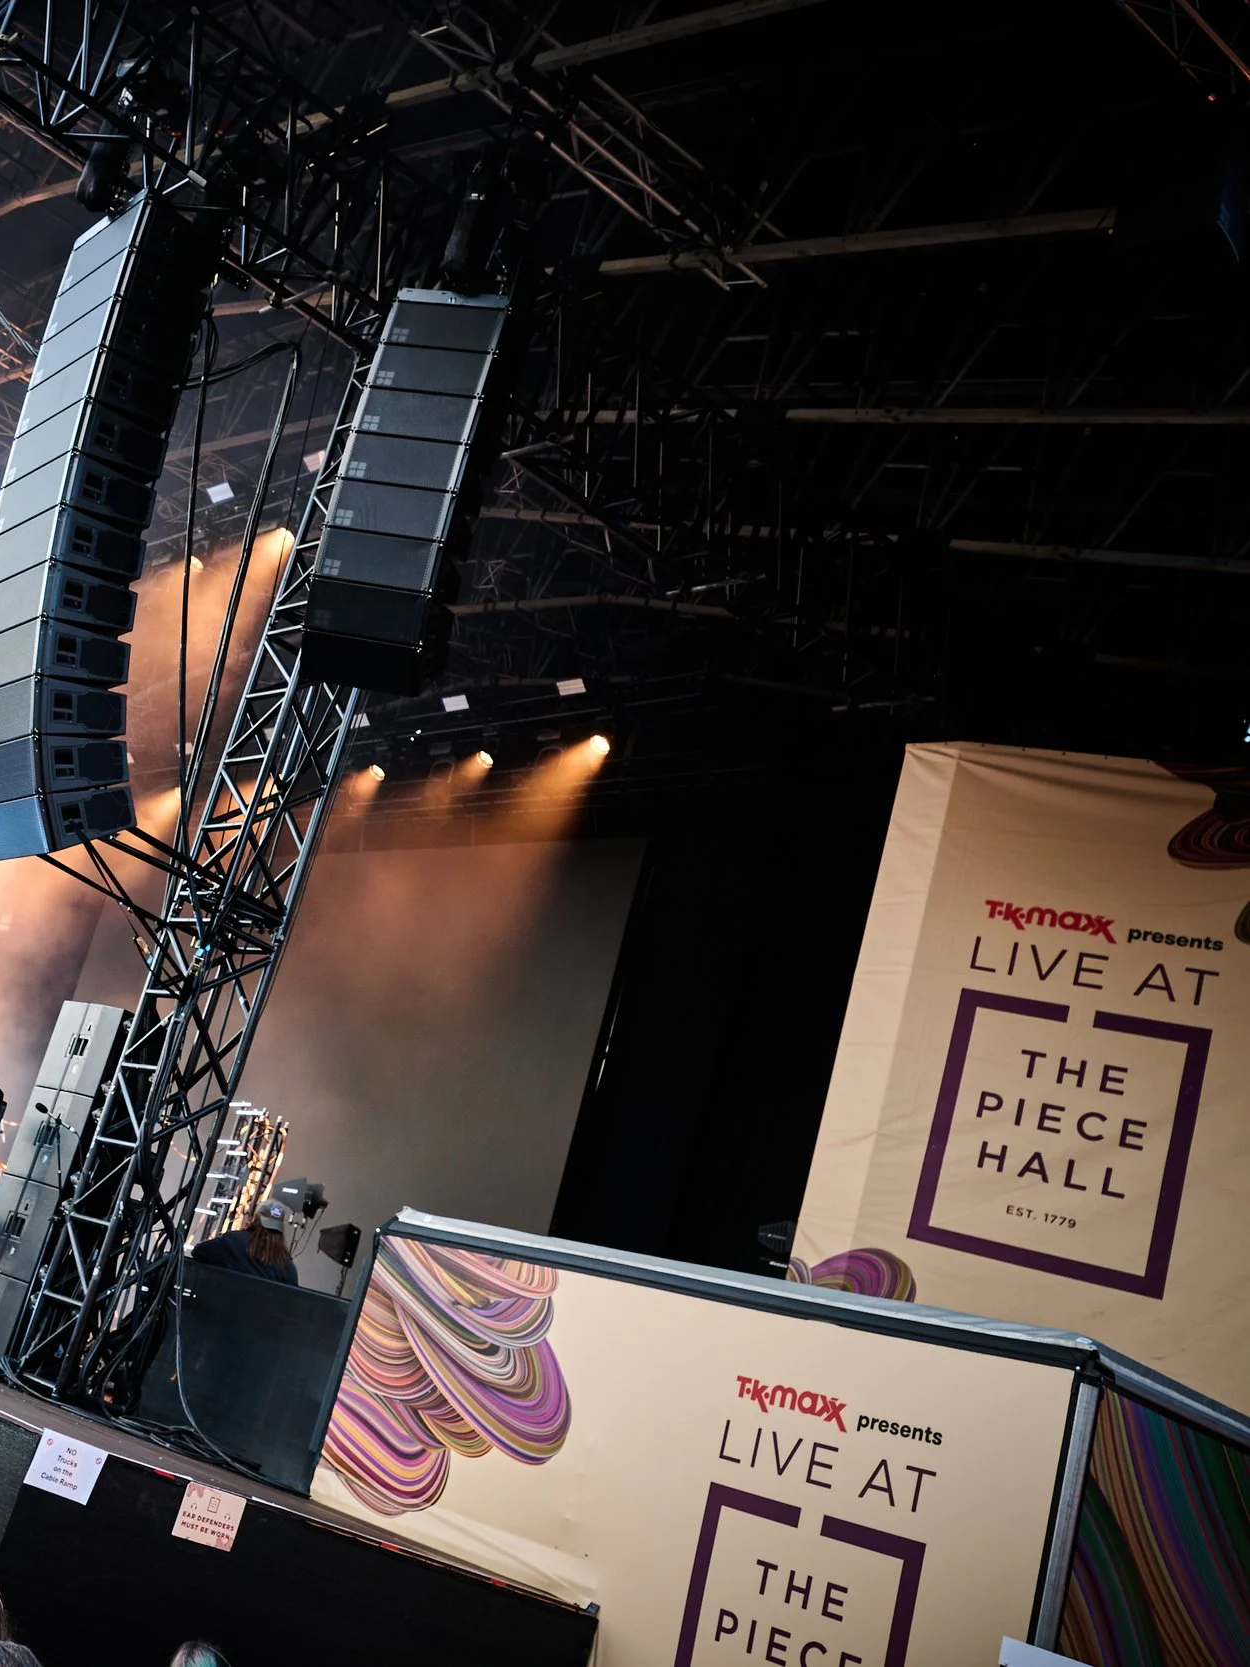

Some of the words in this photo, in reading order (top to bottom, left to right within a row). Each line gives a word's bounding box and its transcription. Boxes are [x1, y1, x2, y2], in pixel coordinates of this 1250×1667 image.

[1127, 928, 1224, 951] presents
[970, 935, 1110, 990] LIVE
[1133, 963, 1220, 1006] AT
[1021, 1049, 1129, 1096] THE
[976, 1091, 1148, 1151] PIECE
[977, 1141, 1125, 1199] HALL
[1006, 1204, 1038, 1221] EST.
[1043, 1212, 1077, 1229] 1779
[856, 1414, 944, 1446] presents
[57, 1455, 78, 1468] Trucks
[66, 1447, 78, 1457] NO
[53, 1466, 62, 1474] on
[62, 1468, 73, 1478] the
[719, 1419, 839, 1489] LIVE
[858, 1459, 937, 1513] AT
[40, 1471, 59, 1484] Cable
[59, 1478, 78, 1491] Ramp
[181, 1520, 199, 1531] MUST
[199, 1526, 209, 1535] BE
[182, 1510, 196, 1519] EAR
[197, 1515, 235, 1532] DEFENDERS
[756, 1559, 849, 1622] THE
